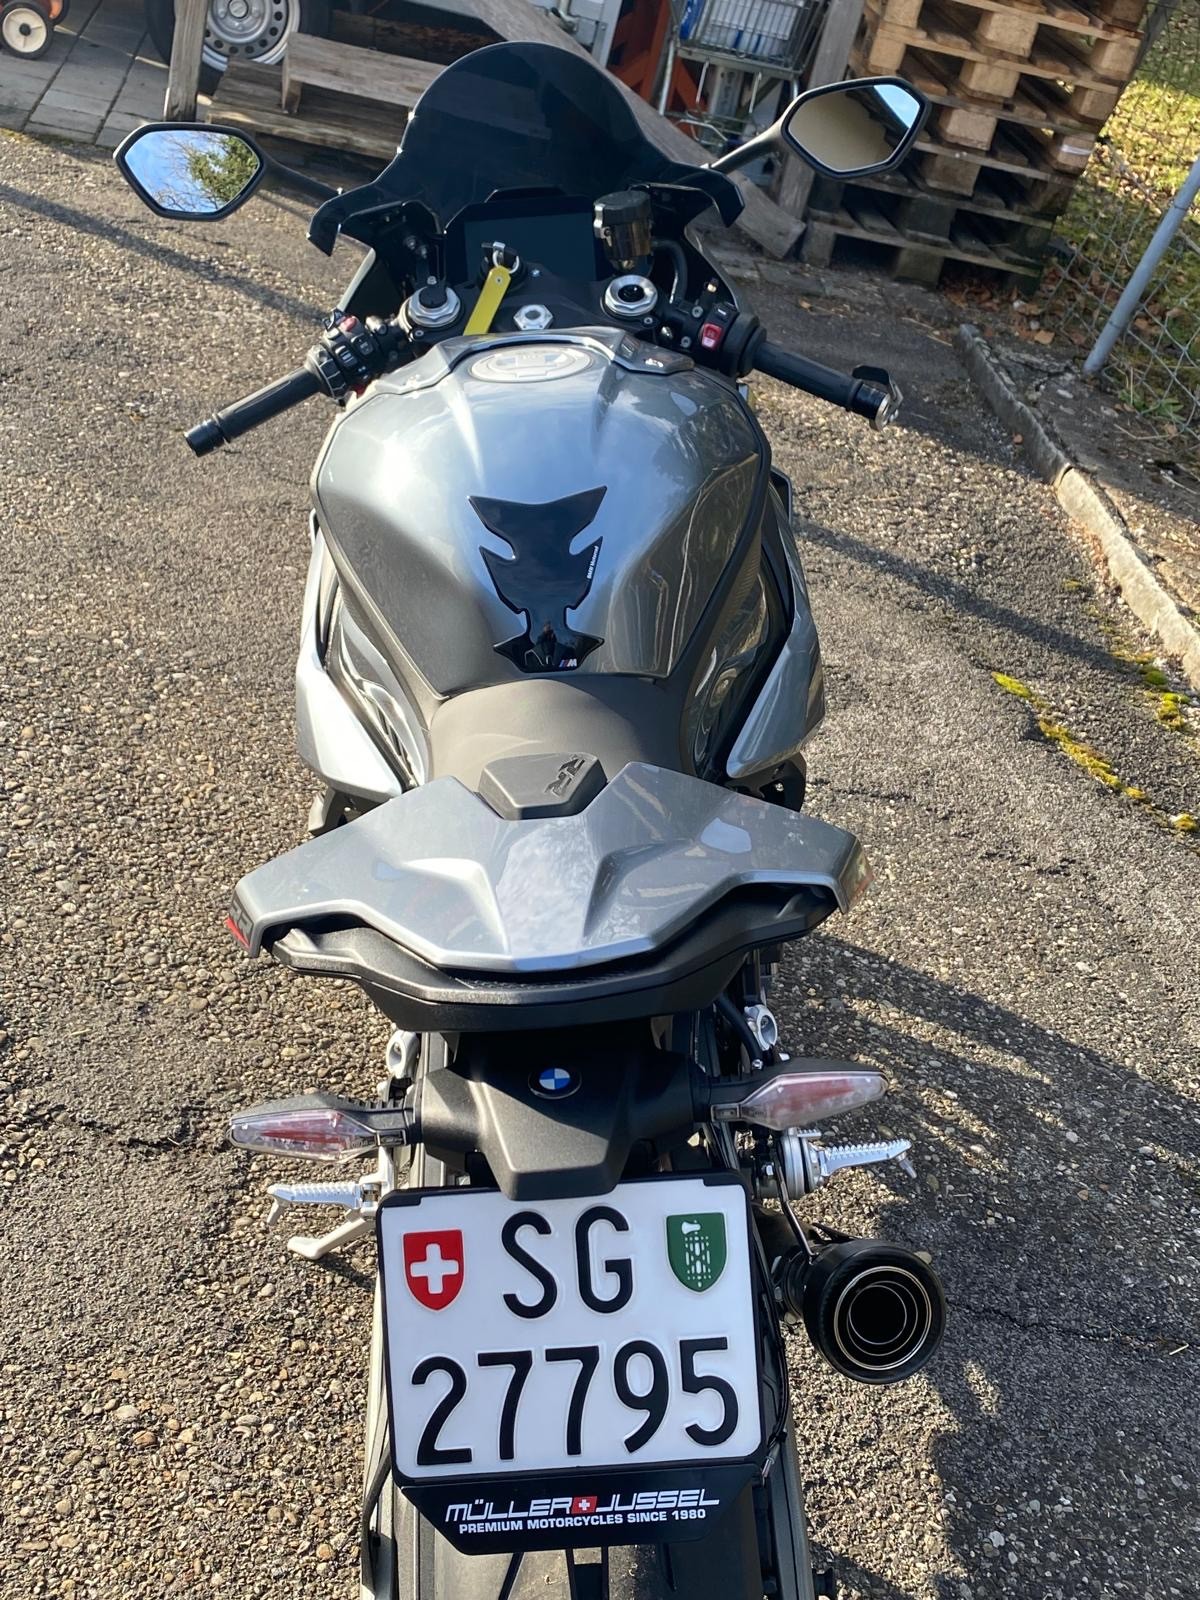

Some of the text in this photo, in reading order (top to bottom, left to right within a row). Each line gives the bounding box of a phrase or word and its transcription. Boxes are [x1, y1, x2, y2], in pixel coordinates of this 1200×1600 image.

[501, 1205, 634, 1319] SG
[411, 1337, 739, 1466] 27795
[445, 1488, 720, 1522] MÜLLER JUSSEL
[459, 1508, 706, 1534] PREMIUM MOTORCYCLES SINCE 1980
